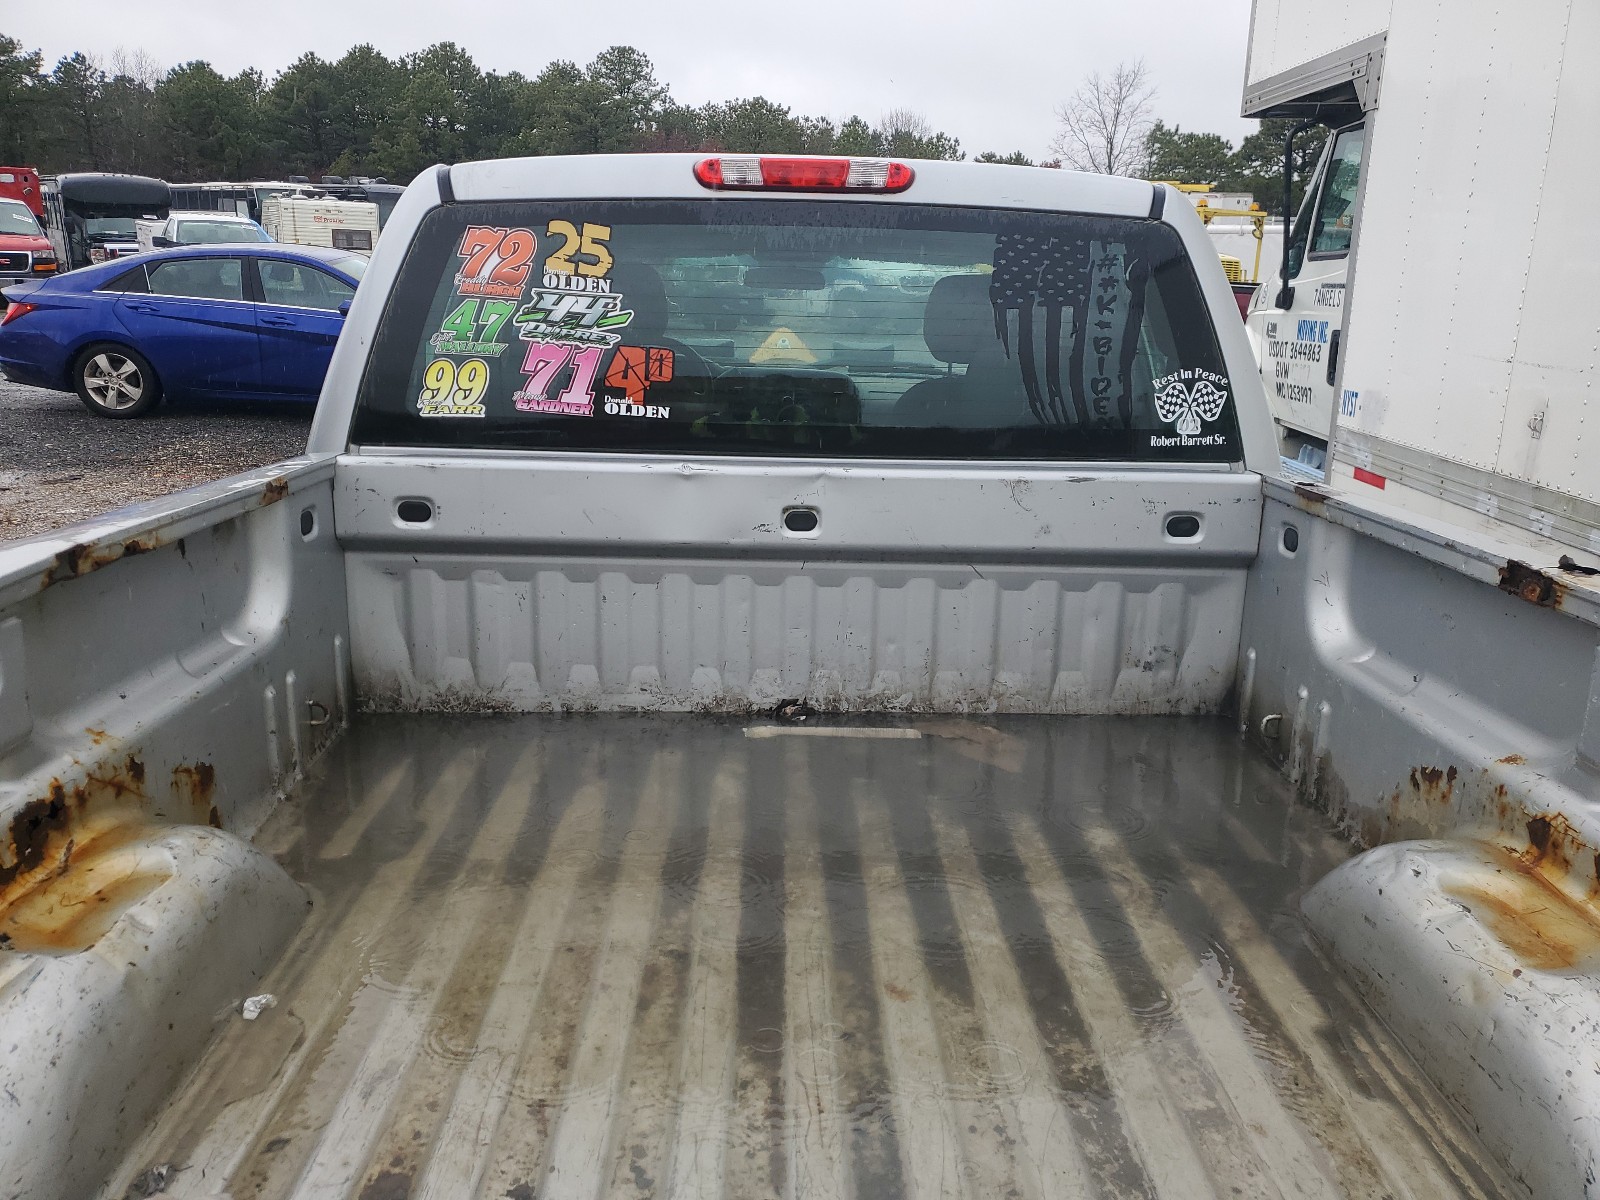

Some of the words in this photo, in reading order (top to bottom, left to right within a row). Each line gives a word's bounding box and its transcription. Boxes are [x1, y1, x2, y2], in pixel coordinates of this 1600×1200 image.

[457, 225, 537, 286] 72
[545, 219, 615, 277] 25
[542, 273, 612, 293] OLDEN
[1313, 288, 1342, 308] 7ANGELS
[441, 298, 518, 344] 47
[1296, 319, 1317, 342] MOVING
[1268, 340, 1289, 358] USDOT
[1289, 341, 1321, 363] 3644863
[520, 341, 605, 405] 71
[1152, 371, 1179, 390] Rest
[1180, 368, 1192, 380] In
[1194, 367, 1229, 387] Peace
[1275, 360, 1289, 379] GVW
[421, 358, 489, 406] 99
[1275, 381, 1286, 399] MC
[422, 404, 484, 415] FARR
[515, 398, 592, 416] GARDNER
[604, 394, 634, 405] Donald
[1341, 389, 1359, 418] NYST
[603, 402, 670, 419] OLDEN
[1150, 434, 1180, 447] Robert
[1181, 434, 1214, 446] Barrett
[1215, 433, 1227, 445] Sr.
